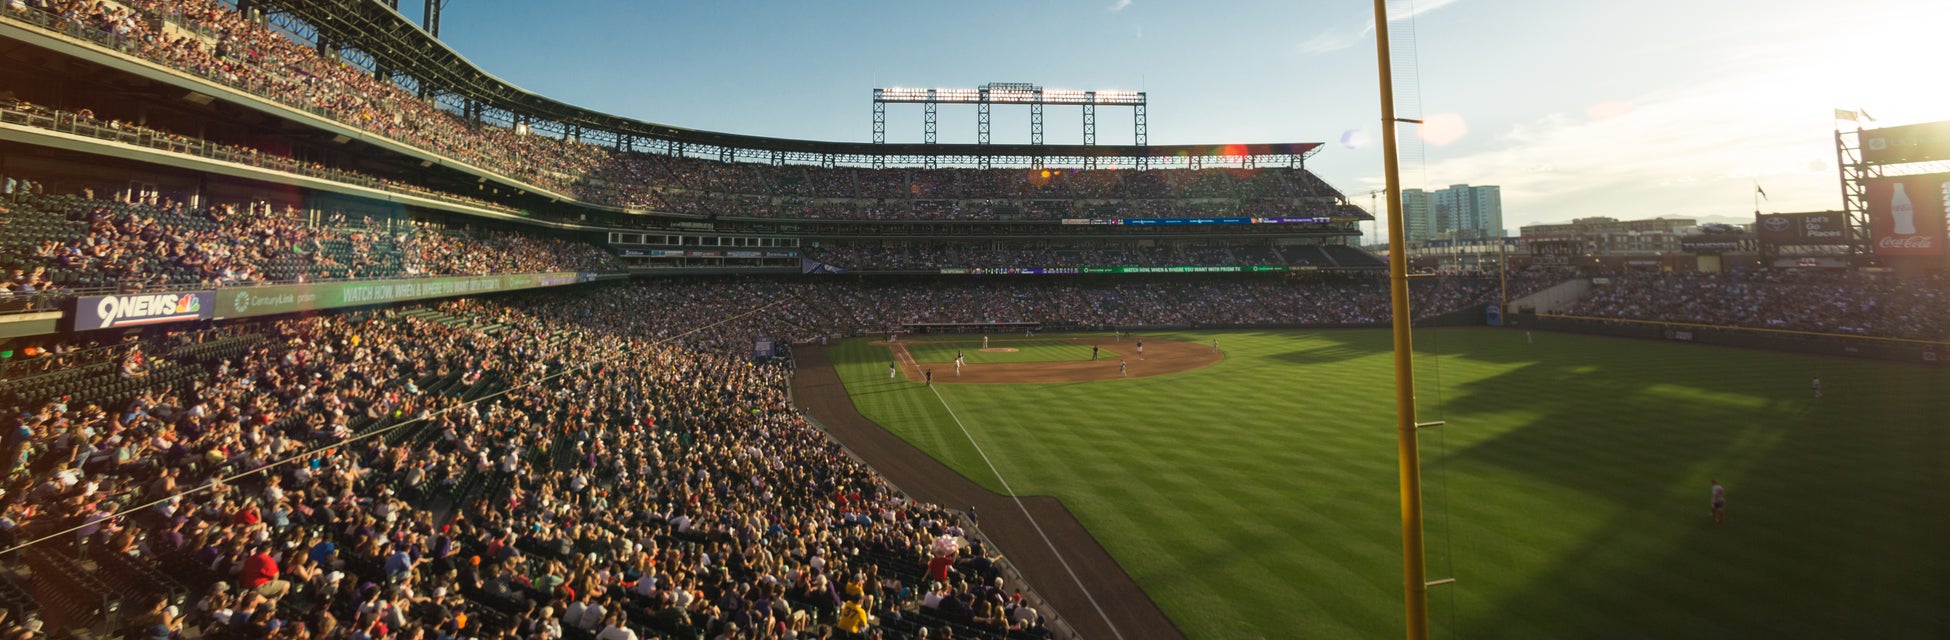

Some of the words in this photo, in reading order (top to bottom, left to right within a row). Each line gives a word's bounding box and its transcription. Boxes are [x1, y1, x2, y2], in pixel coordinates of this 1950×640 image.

[1806, 216, 1830, 224] Let's
[251, 294, 294, 306] CenturyLink
[344, 286, 374, 303] WATCH
[395, 284, 415, 299] WHEN
[97, 294, 179, 328] 9NEWS
